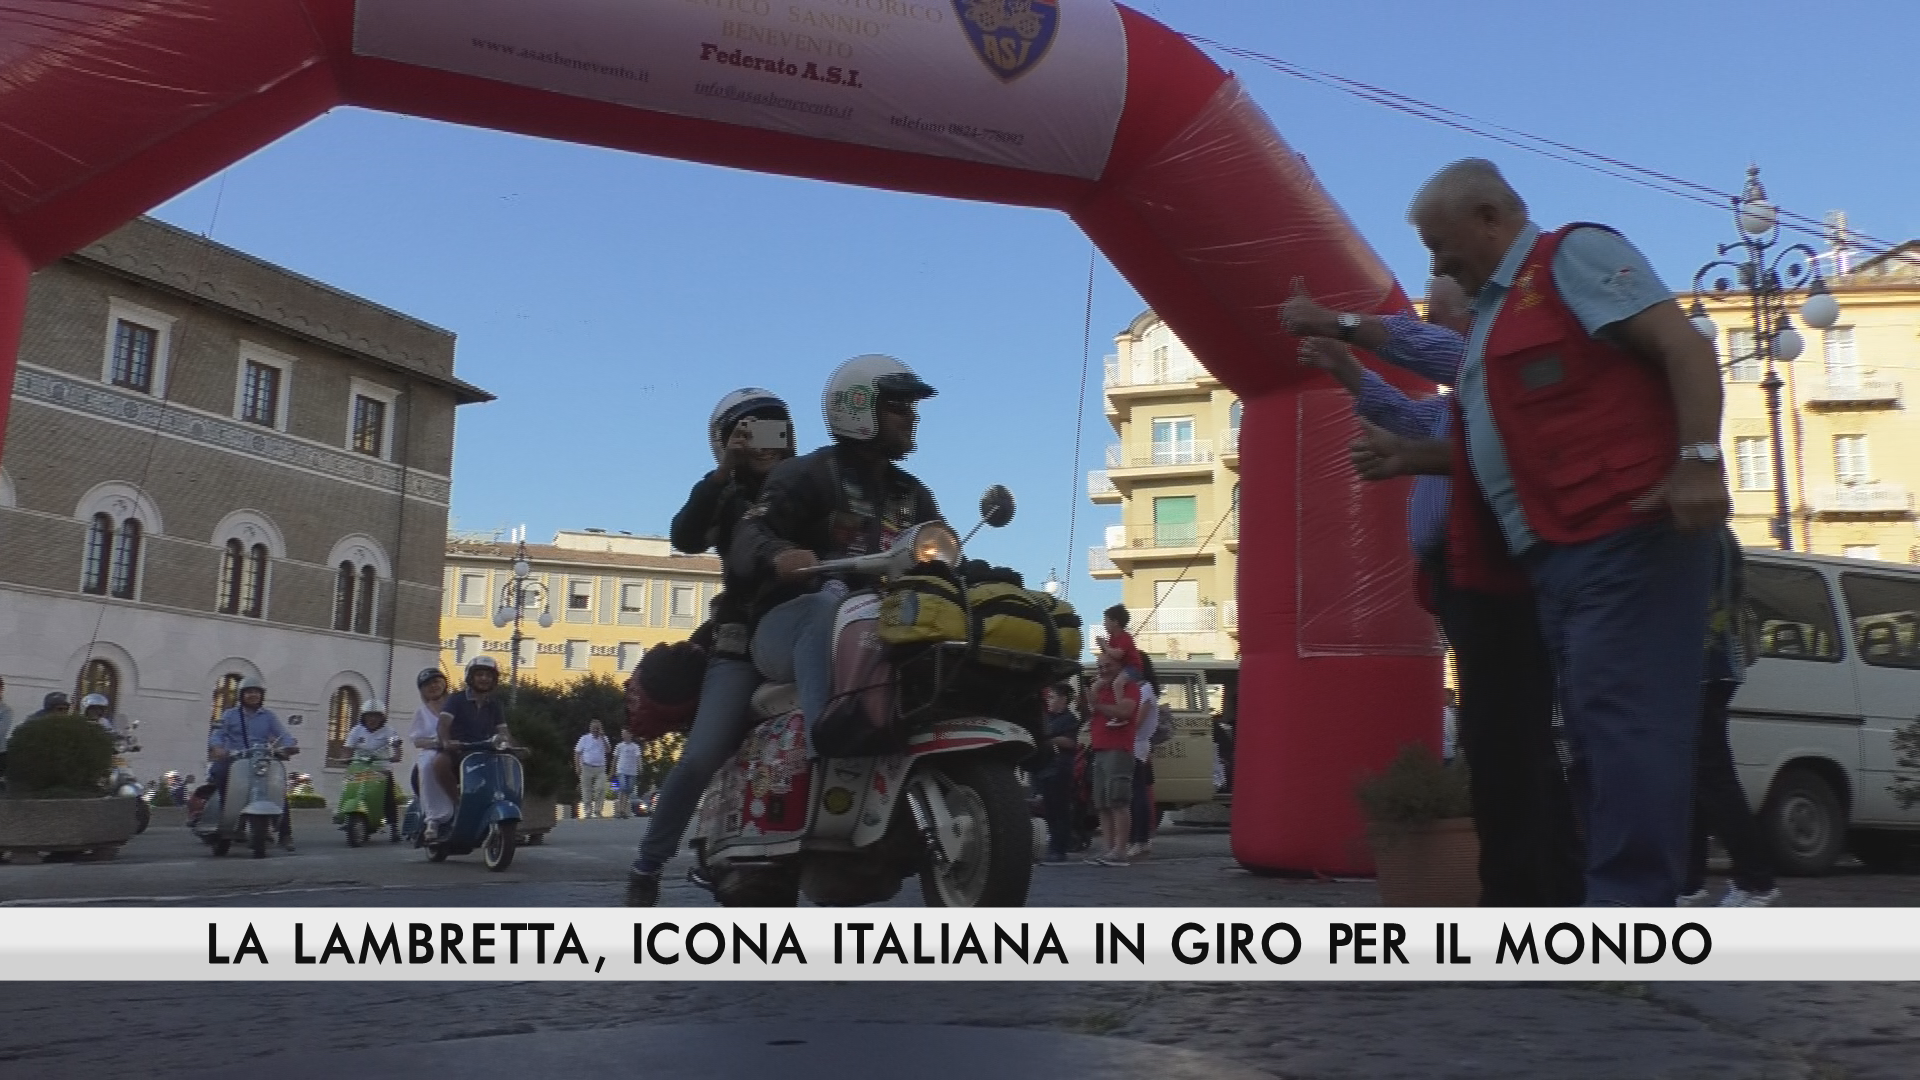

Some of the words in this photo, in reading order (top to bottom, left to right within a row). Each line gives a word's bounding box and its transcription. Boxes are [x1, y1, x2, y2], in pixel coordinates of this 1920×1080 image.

[721, 19, 854, 59] BENEVENTO
[982, 34, 1033, 70] ASI
[471, 37, 650, 82] www.asasbenevento.it
[700, 42, 799, 77] Federato
[801, 61, 864, 89] A.S.I.
[694, 80, 856, 116] info@asasbenevento.it
[890, 115, 946, 134] telefono
